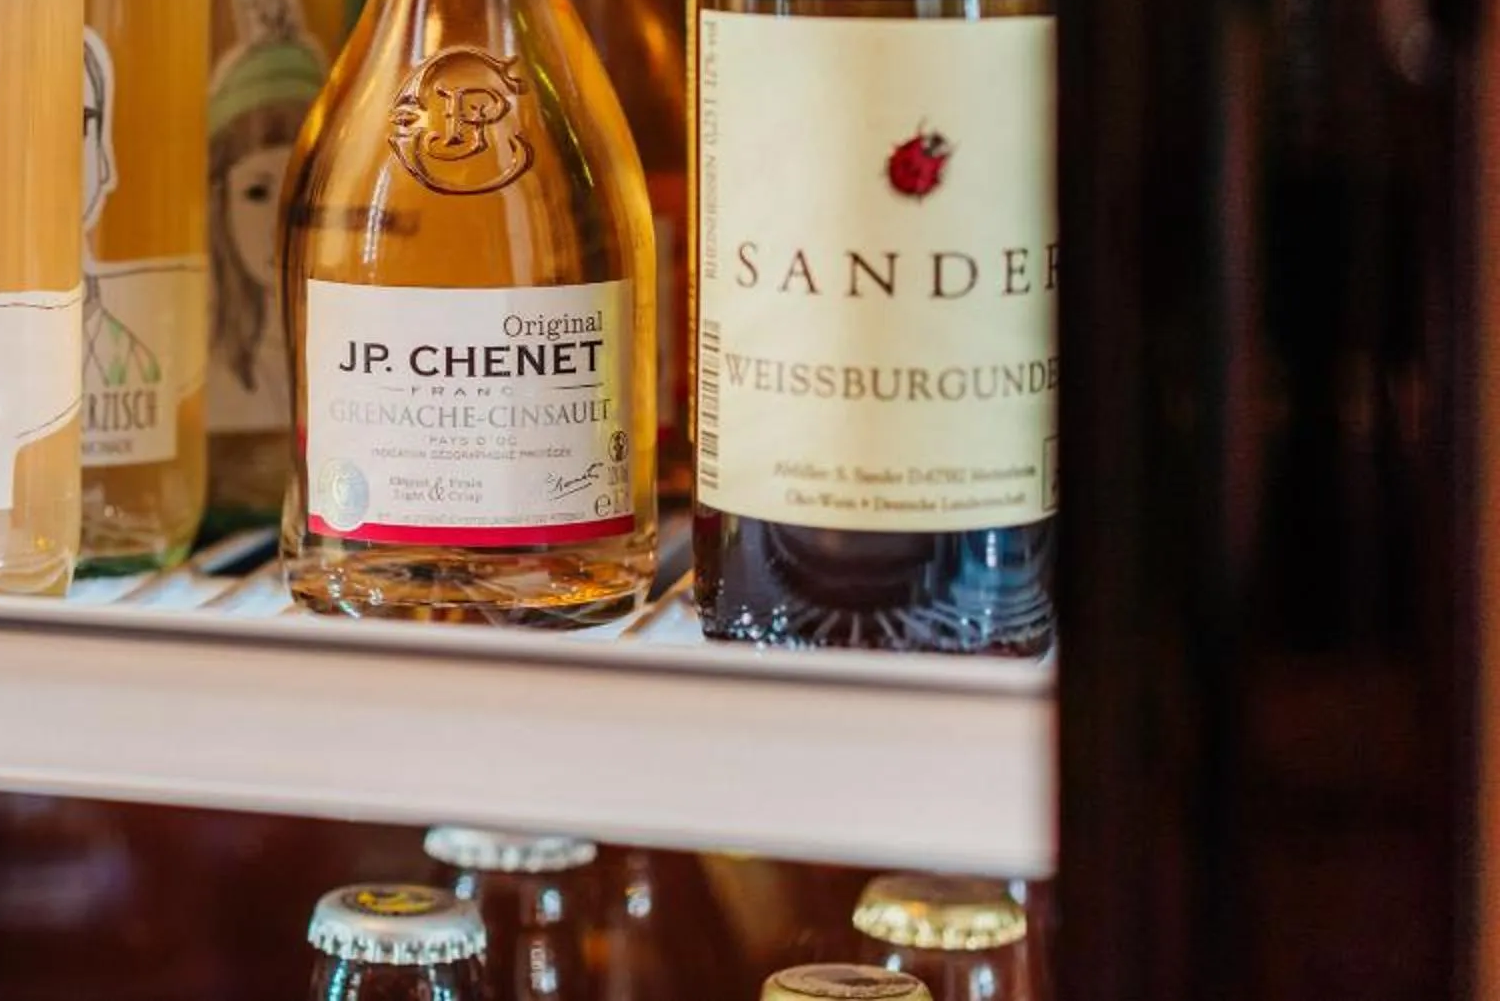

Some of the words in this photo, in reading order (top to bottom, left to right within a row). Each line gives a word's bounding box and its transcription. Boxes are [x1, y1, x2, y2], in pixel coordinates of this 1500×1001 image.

[503, 310, 604, 341] Original
[339, 340, 392, 374] JP.
[409, 340, 604, 378] CHENET
[411, 386, 515, 398] FRANC
[725, 352, 1059, 402] WEISSBURGUNDE
[329, 398, 612, 429] GRENACHE-CINSAULT
